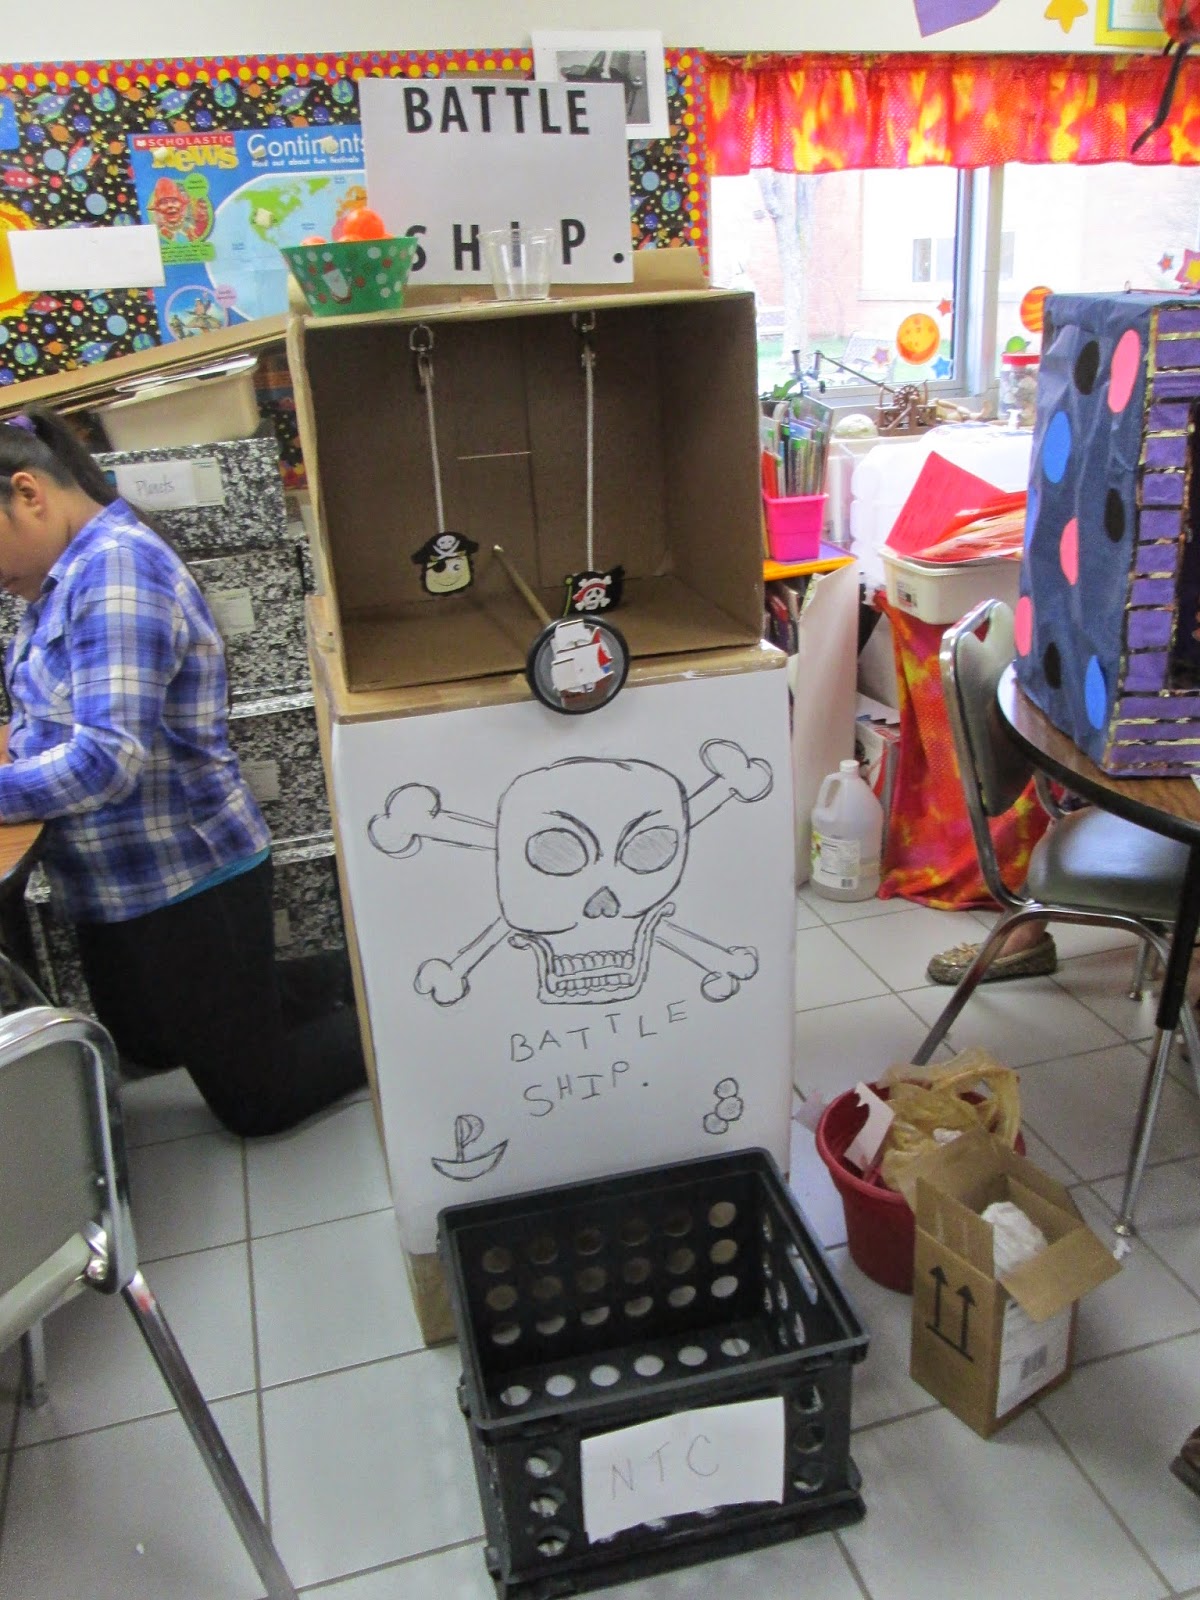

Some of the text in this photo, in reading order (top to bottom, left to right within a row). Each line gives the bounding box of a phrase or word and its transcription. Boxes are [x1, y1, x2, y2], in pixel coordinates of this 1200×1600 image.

[403, 86, 590, 135] BATTLE
[148, 135, 233, 147] SCHOLASTIC
[247, 133, 365, 157] Continnt
[510, 1000, 687, 1062] BATTLE
[611, 1433, 720, 1501] NTC
